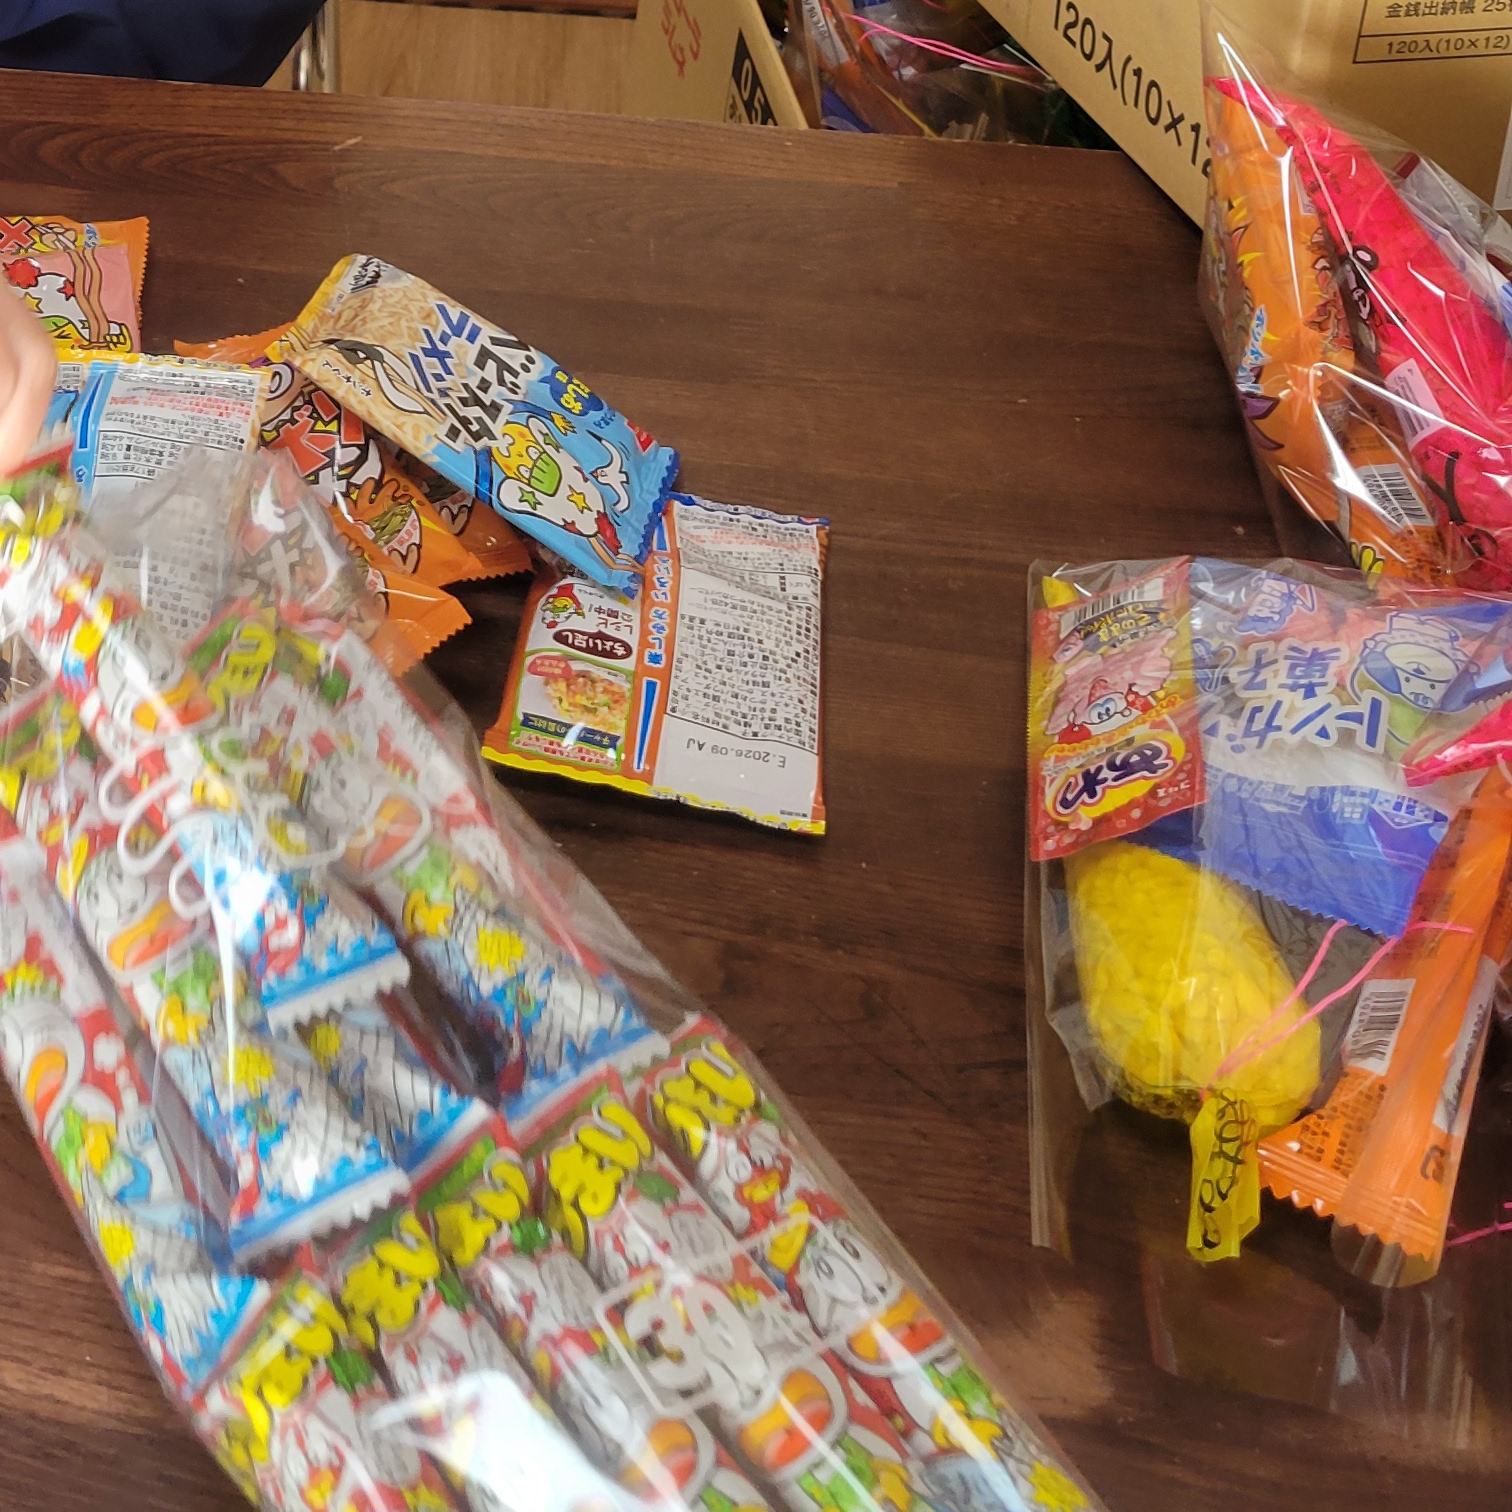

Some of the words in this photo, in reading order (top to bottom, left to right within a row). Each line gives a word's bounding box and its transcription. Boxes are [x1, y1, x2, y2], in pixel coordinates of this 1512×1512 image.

[1387, 35, 1510, 54] 120入(10×12)
[406, 302, 482, 417] ラーメン
[443, 335, 538, 448] ベビースター
[562, 631, 629, 657] ちょい足し
[1235, 645, 1340, 700] 菓子
[686, 737, 707, 752] AJ
[1058, 742, 1170, 811] あわ
